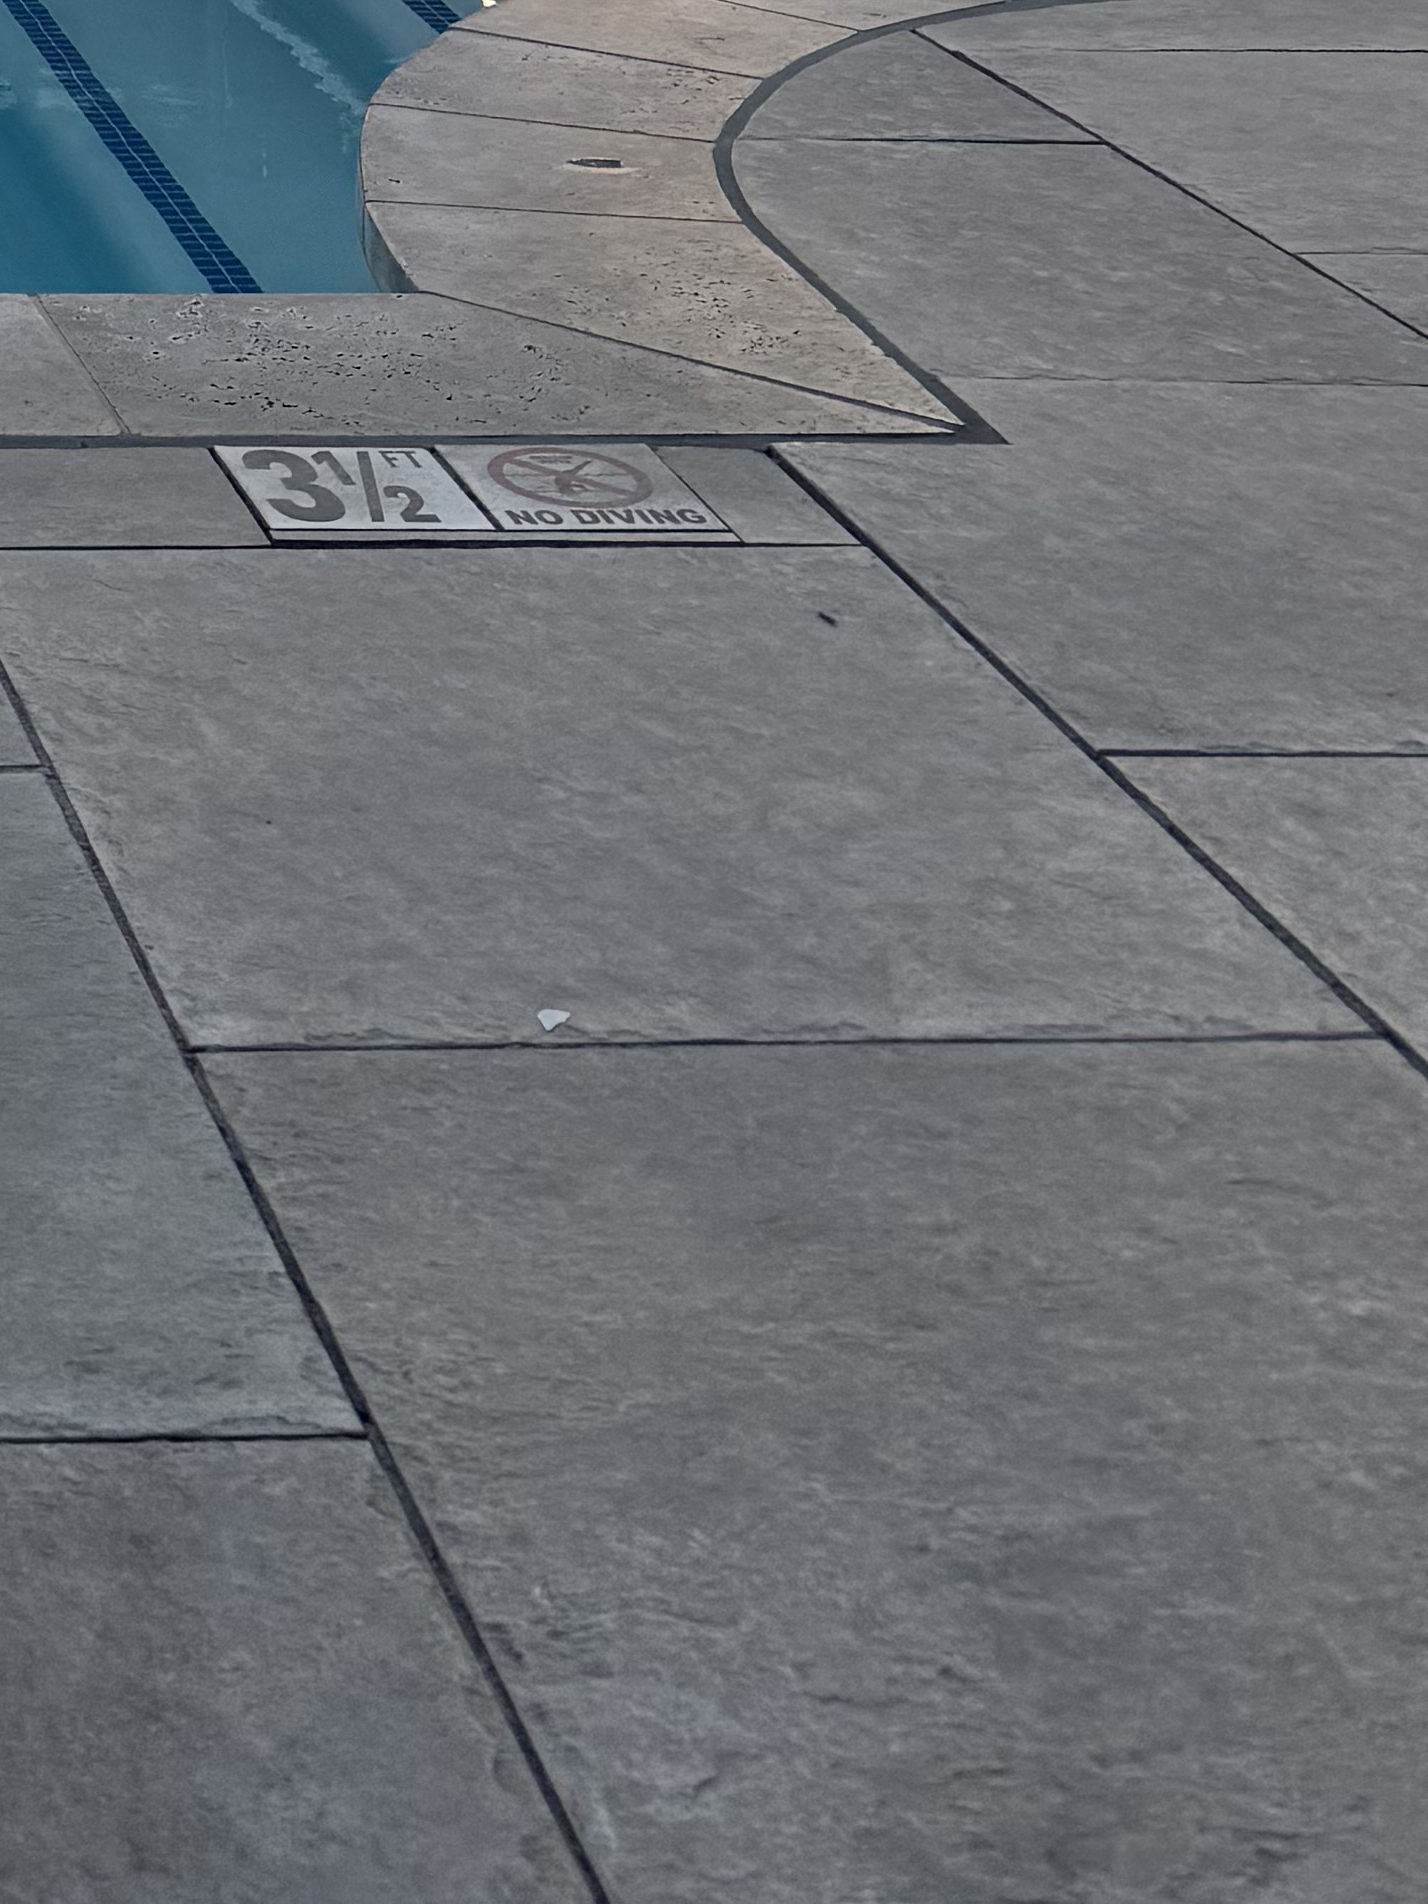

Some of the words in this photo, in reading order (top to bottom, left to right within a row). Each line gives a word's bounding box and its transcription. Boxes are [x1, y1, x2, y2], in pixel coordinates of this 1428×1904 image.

[377, 450, 423, 469] FT
[504, 509, 564, 525] NO
[570, 508, 708, 525] DIVING
